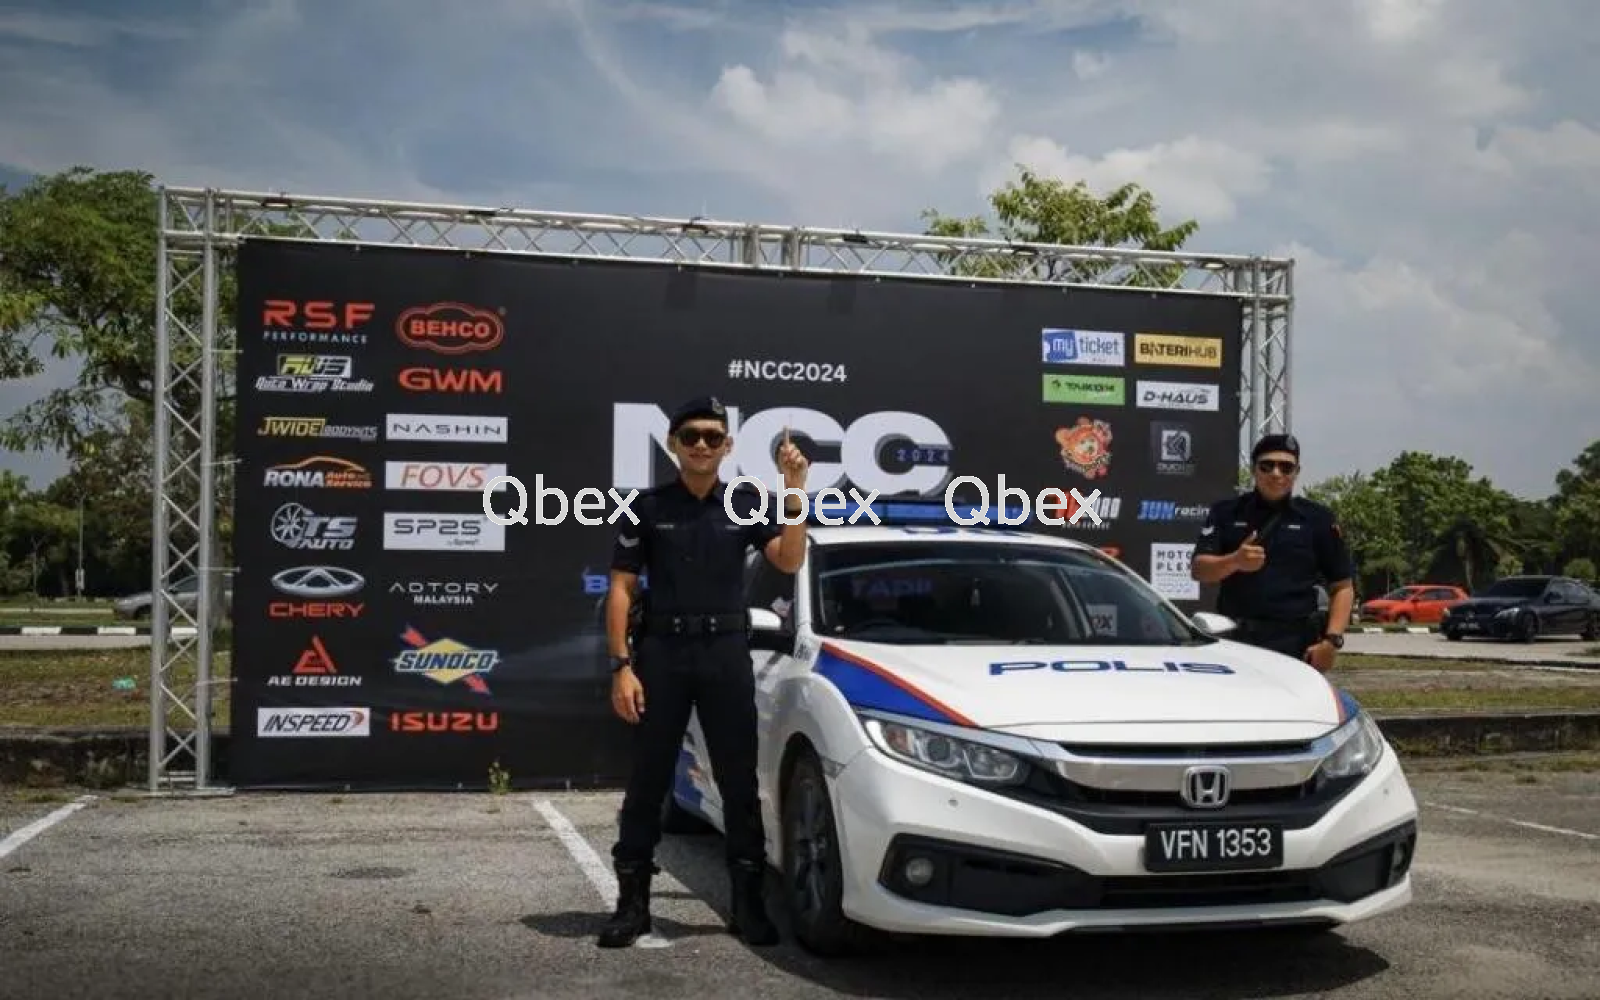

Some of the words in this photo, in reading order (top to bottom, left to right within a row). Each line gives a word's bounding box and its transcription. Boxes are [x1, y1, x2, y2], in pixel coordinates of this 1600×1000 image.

[263, 300, 375, 329] RSF
[263, 331, 368, 344] PERFORMANCE
[410, 319, 491, 338] BEHCO
[399, 367, 503, 393] GWM
[728, 360, 848, 382] #NCC2024
[1143, 391, 1209, 405] D-HAUS
[393, 423, 501, 435] NASHIN
[613, 402, 954, 496] NCC
[264, 470, 324, 487] RONA
[401, 466, 486, 487] FOVS
[302, 516, 358, 537] TS
[299, 538, 355, 550] AUTO
[413, 595, 473, 605] MALAYSIA
[269, 602, 365, 618] CHERY
[399, 651, 496, 671] SUNOCO
[988, 660, 1236, 676] POLIS
[267, 675, 292, 687] AE
[295, 675, 362, 687] DESIGN
[263, 713, 350, 732] INSPEED
[391, 711, 498, 731] ISUZU
[1160, 829, 1209, 860] VFN
[1216, 827, 1272, 858] 1353
